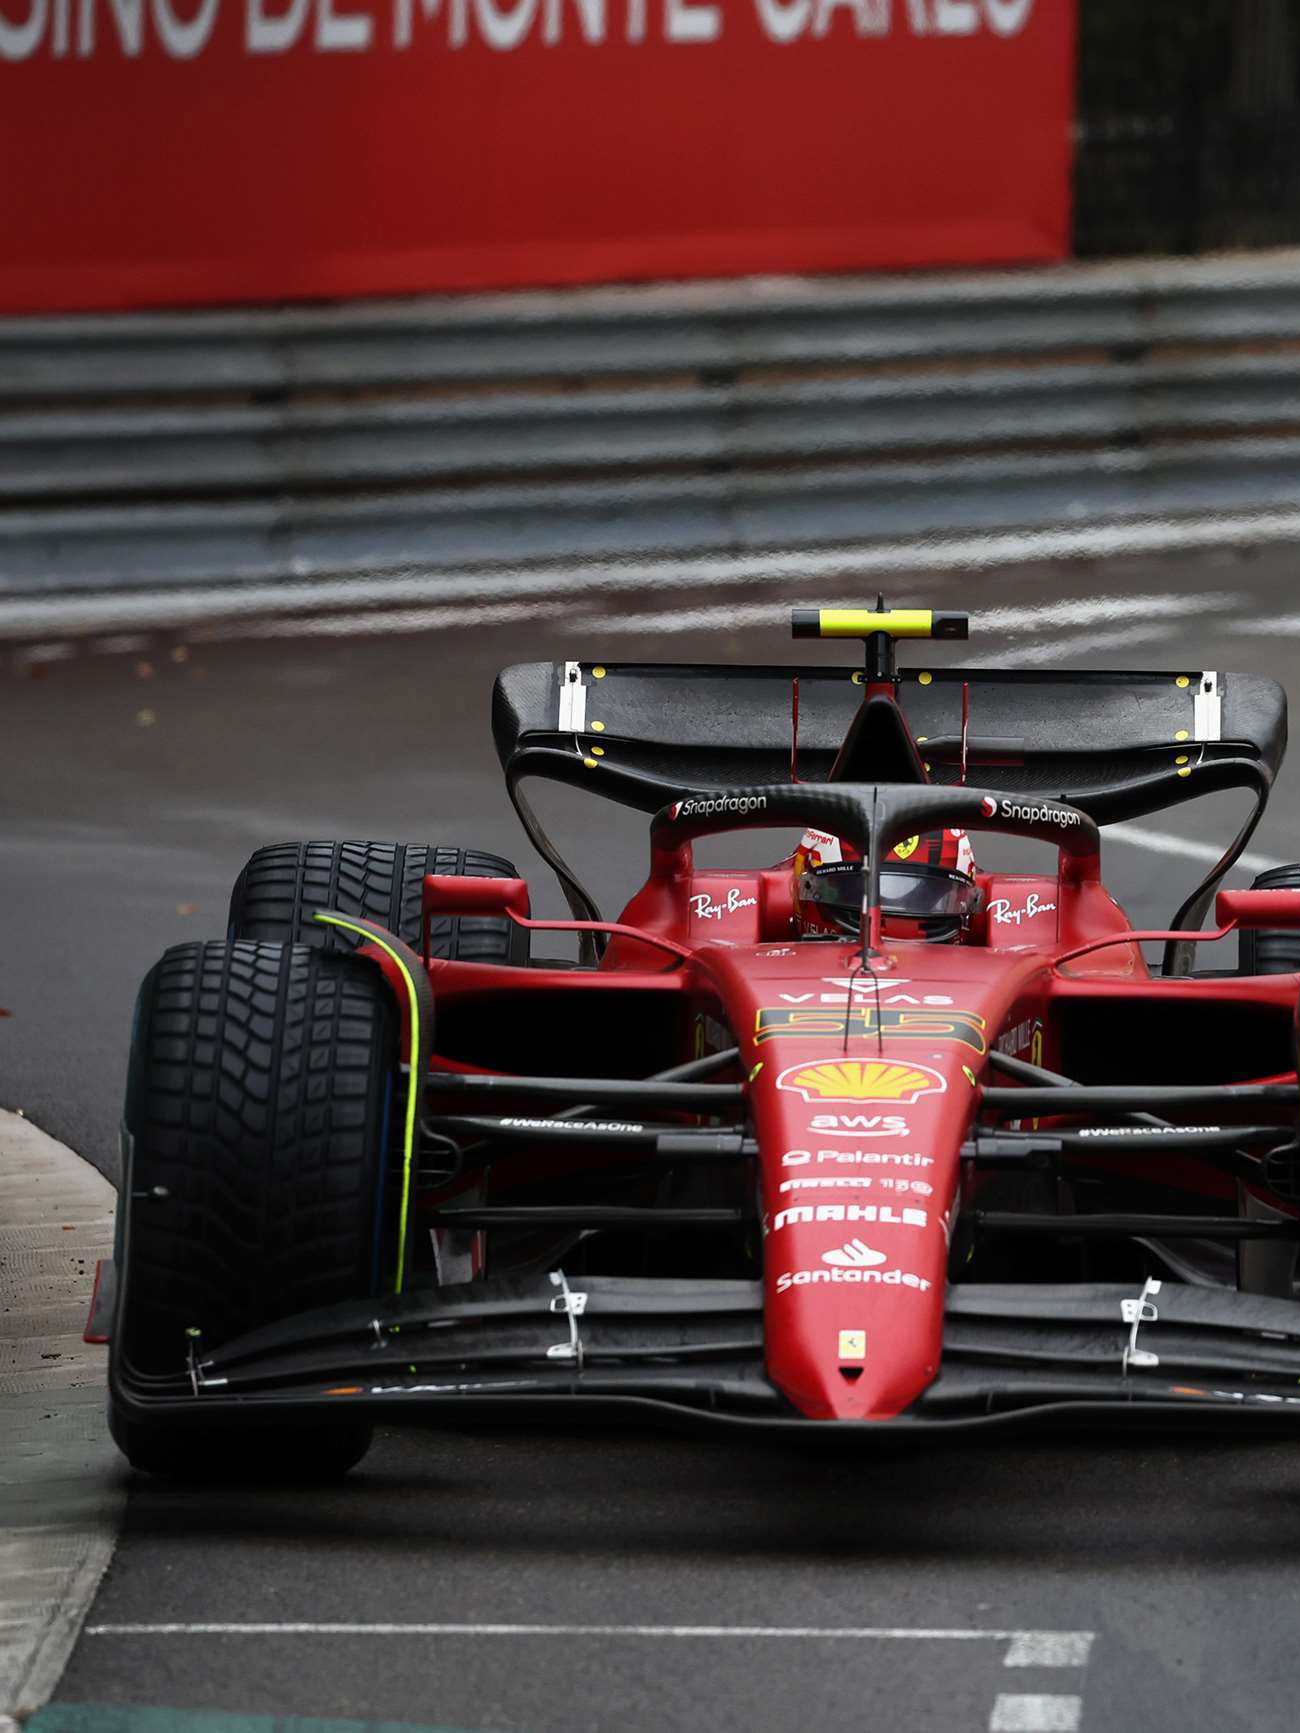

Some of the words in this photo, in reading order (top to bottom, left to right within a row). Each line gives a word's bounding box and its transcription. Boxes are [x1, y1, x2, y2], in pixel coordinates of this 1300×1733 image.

[682, 795, 767, 816] Snapdragon
[1001, 800, 1080, 828] Snapdragon
[689, 888, 758, 919] Ray-Ban
[986, 893, 1056, 925] Ray-Ban
[778, 993, 954, 1006] VELAS
[753, 1007, 986, 1056] 55
[499, 1117, 643, 1133] #WeRaceAsOne
[810, 1114, 908, 1129] aws
[816, 1150, 934, 1167] Palantir
[774, 1204, 928, 1231] MAHLE
[776, 1266, 932, 1294] Santander
